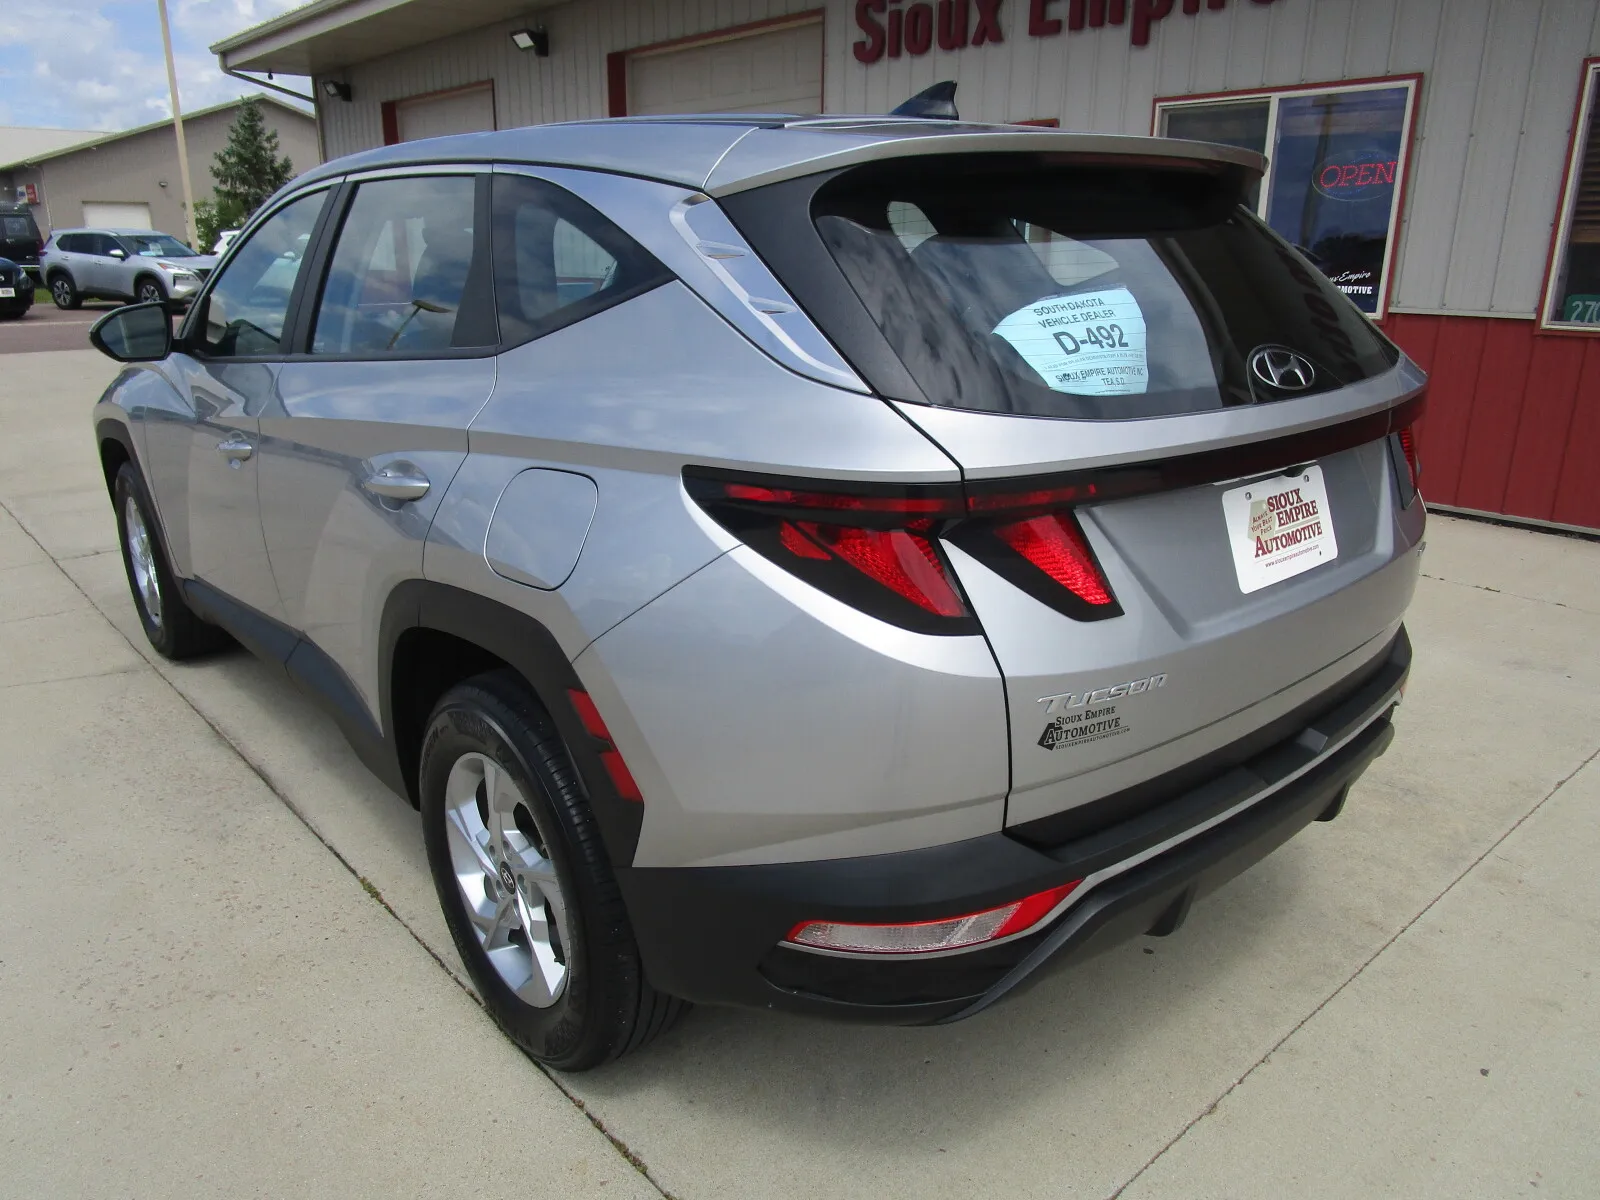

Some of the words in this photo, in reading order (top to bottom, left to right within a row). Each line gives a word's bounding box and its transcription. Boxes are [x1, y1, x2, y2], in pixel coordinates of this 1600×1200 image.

[853, 0, 1004, 64] Sioux
[1320, 161, 1399, 188] OPEN
[1033, 302, 1067, 316] SOUTH
[1068, 297, 1105, 311] DAKOTA
[1038, 315, 1081, 329] VEHICLE
[1081, 309, 1116, 321] DEALER
[1052, 323, 1129, 355] D-492
[1055, 371, 1080, 383] SIOUX
[1080, 367, 1106, 379] EMPIRE
[1267, 488, 1303, 513] SIOUX
[1276, 500, 1319, 527] EMPIRE
[1254, 521, 1323, 558] AUTOMOTIVE
[1056, 714, 1083, 727] SIOUX
[1084, 705, 1116, 721] EMPIRE
[1044, 717, 1121, 744] AUTOMOTIVE
